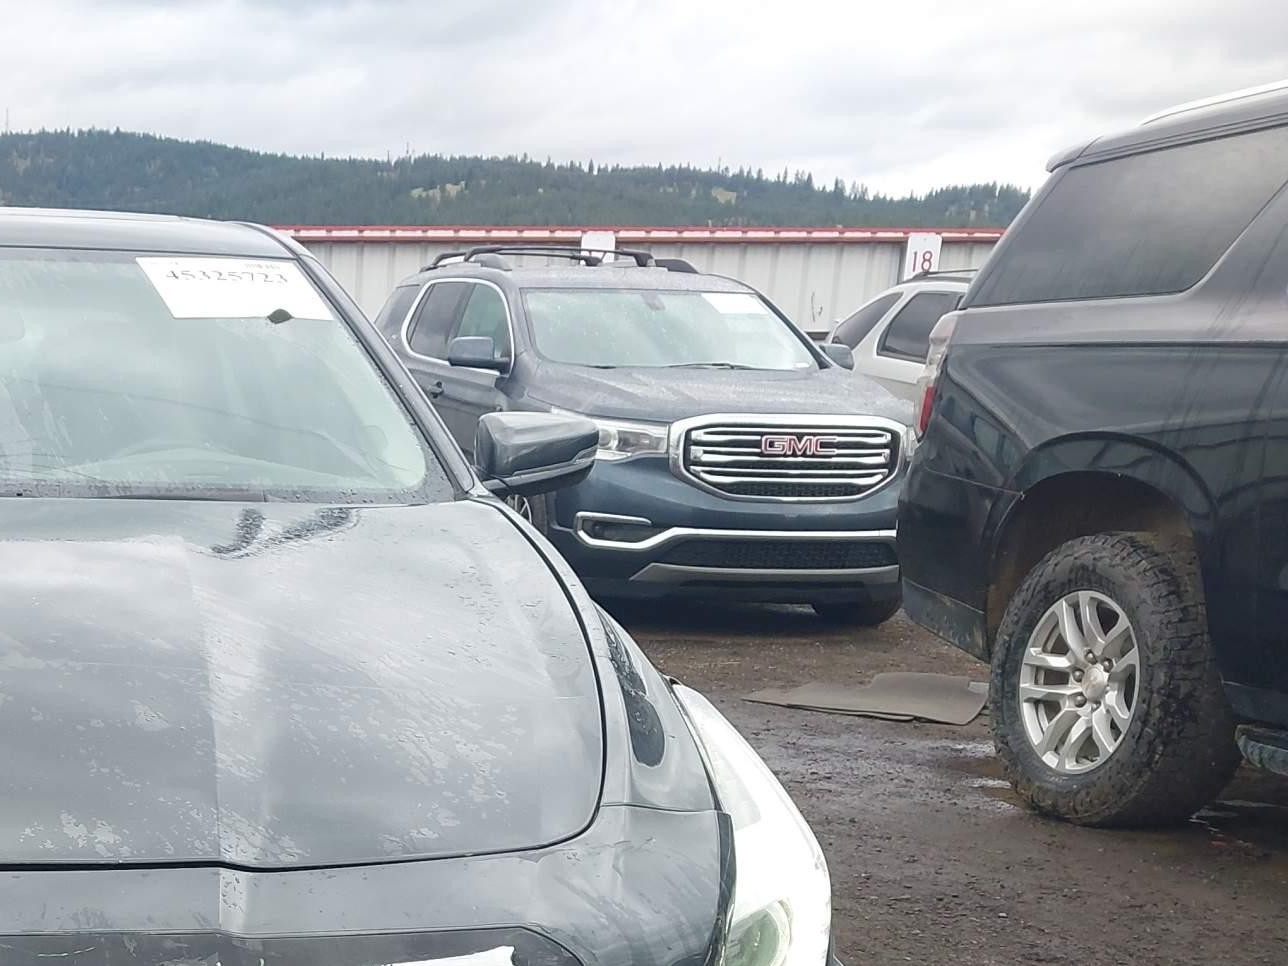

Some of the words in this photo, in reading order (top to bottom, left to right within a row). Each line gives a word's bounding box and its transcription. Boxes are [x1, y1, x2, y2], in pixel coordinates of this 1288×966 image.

[912, 250, 933, 273] 18
[165, 269, 289, 284] 45325723
[761, 434, 838, 456] GMC
